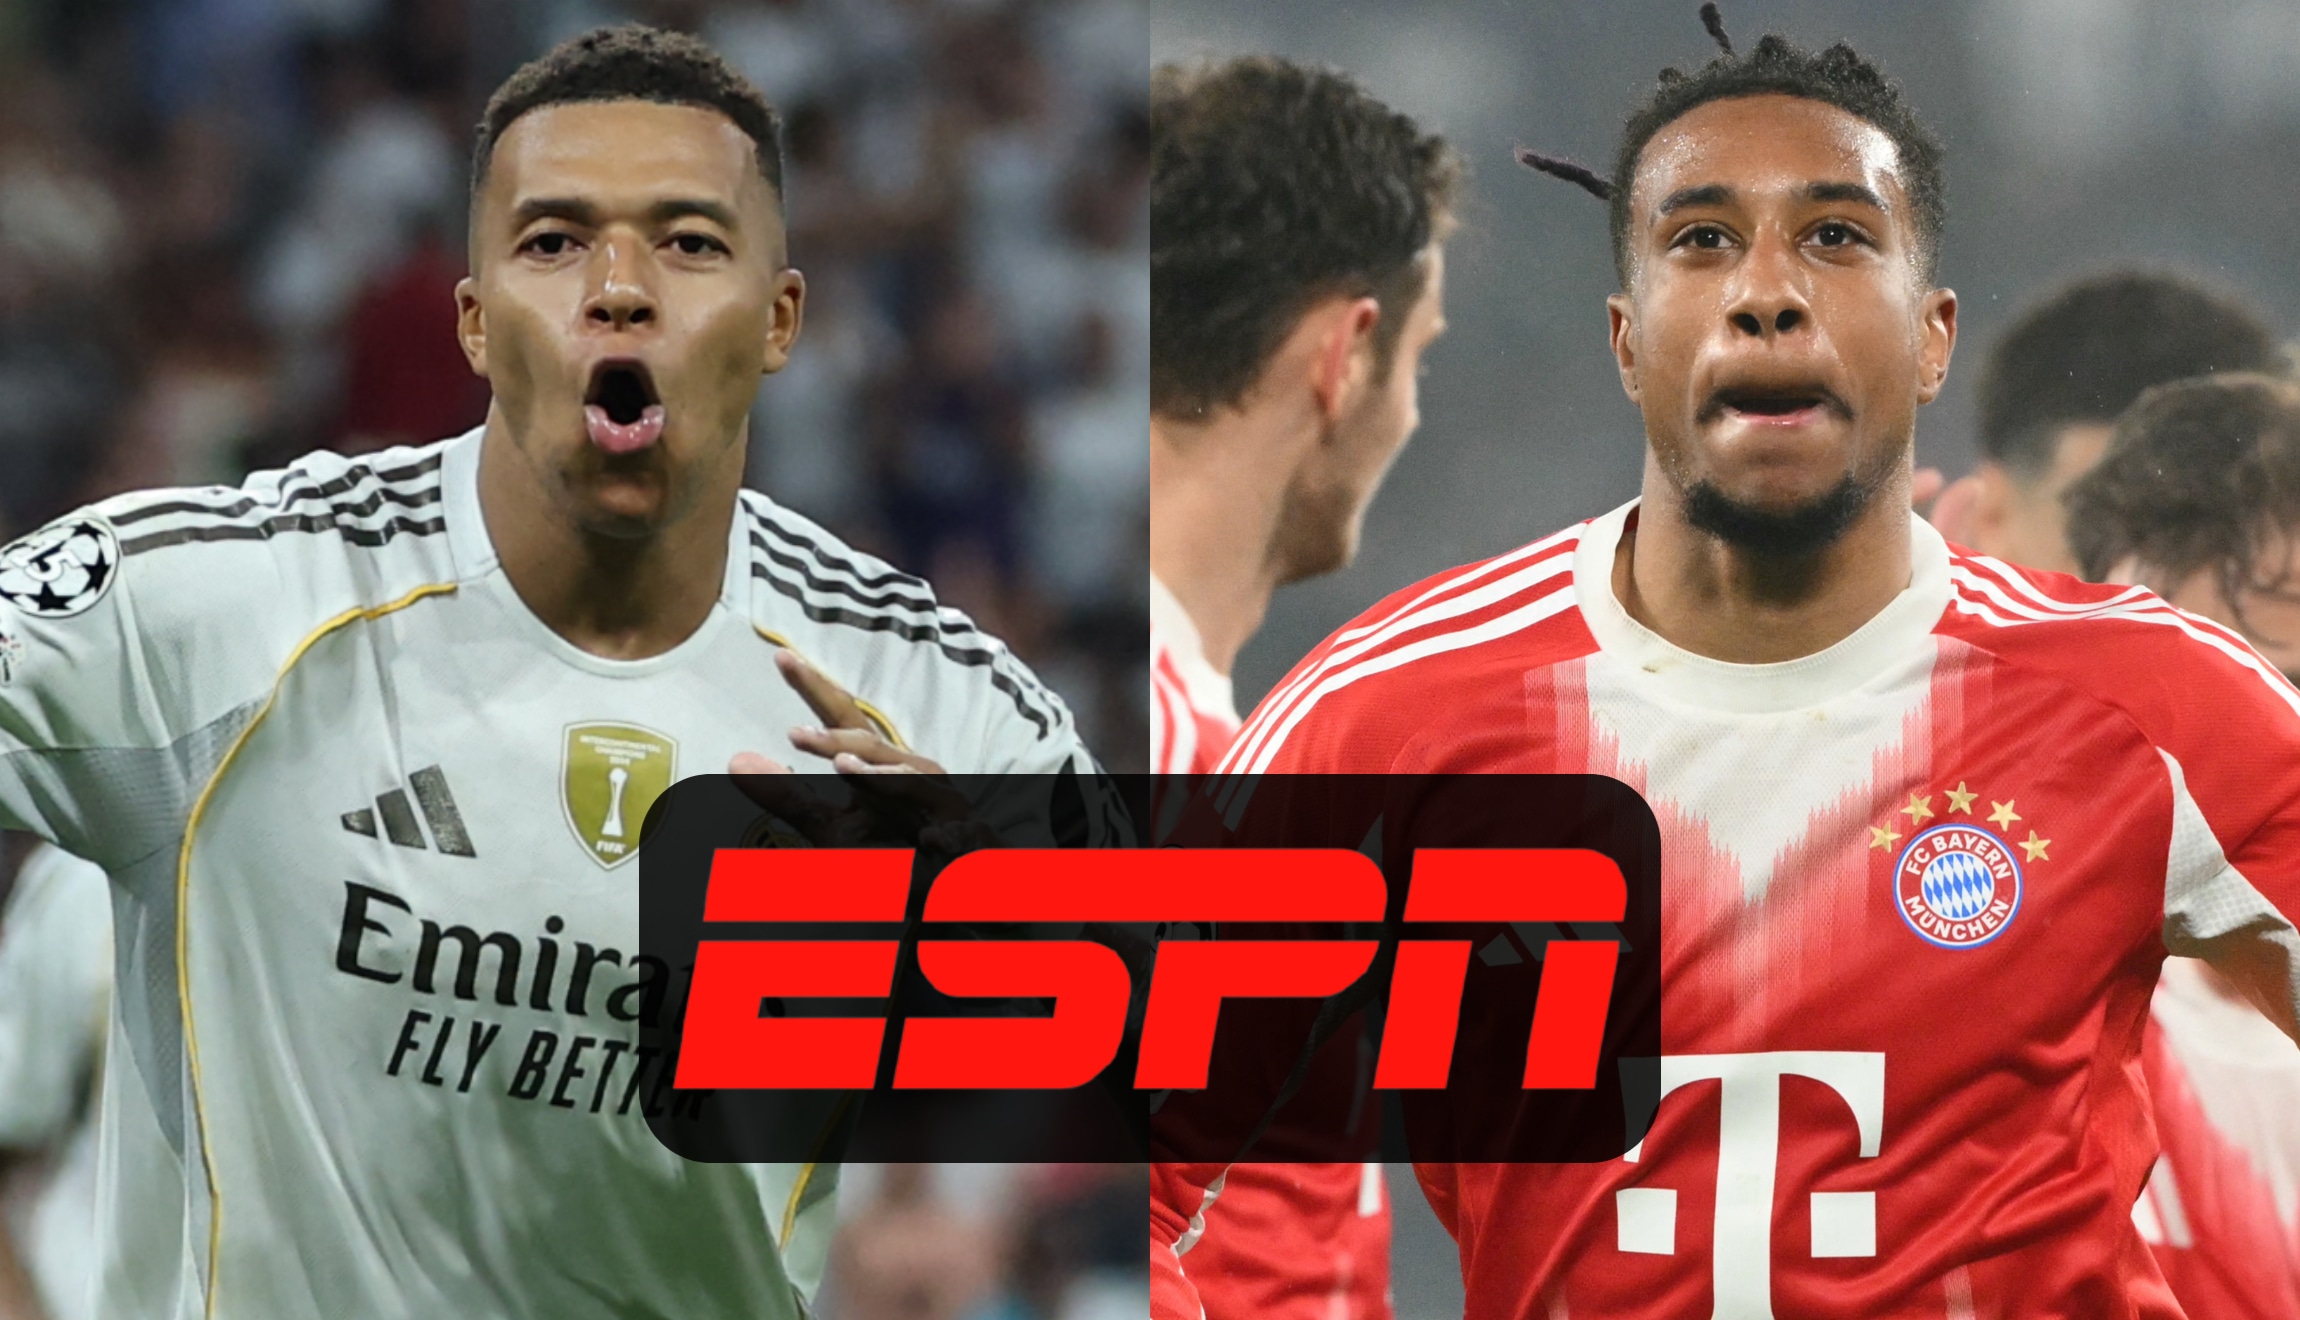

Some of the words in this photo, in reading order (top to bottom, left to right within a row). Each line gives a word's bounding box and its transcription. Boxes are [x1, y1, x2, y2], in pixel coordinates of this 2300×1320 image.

[596, 840, 627, 854] FIFA
[1905, 847, 1931, 876] FC
[1931, 833, 2012, 880] BAYERN
[1905, 895, 2010, 940] MÜNCHEN
[336, 880, 698, 1035] Emira
[386, 1009, 501, 1094] FLY
